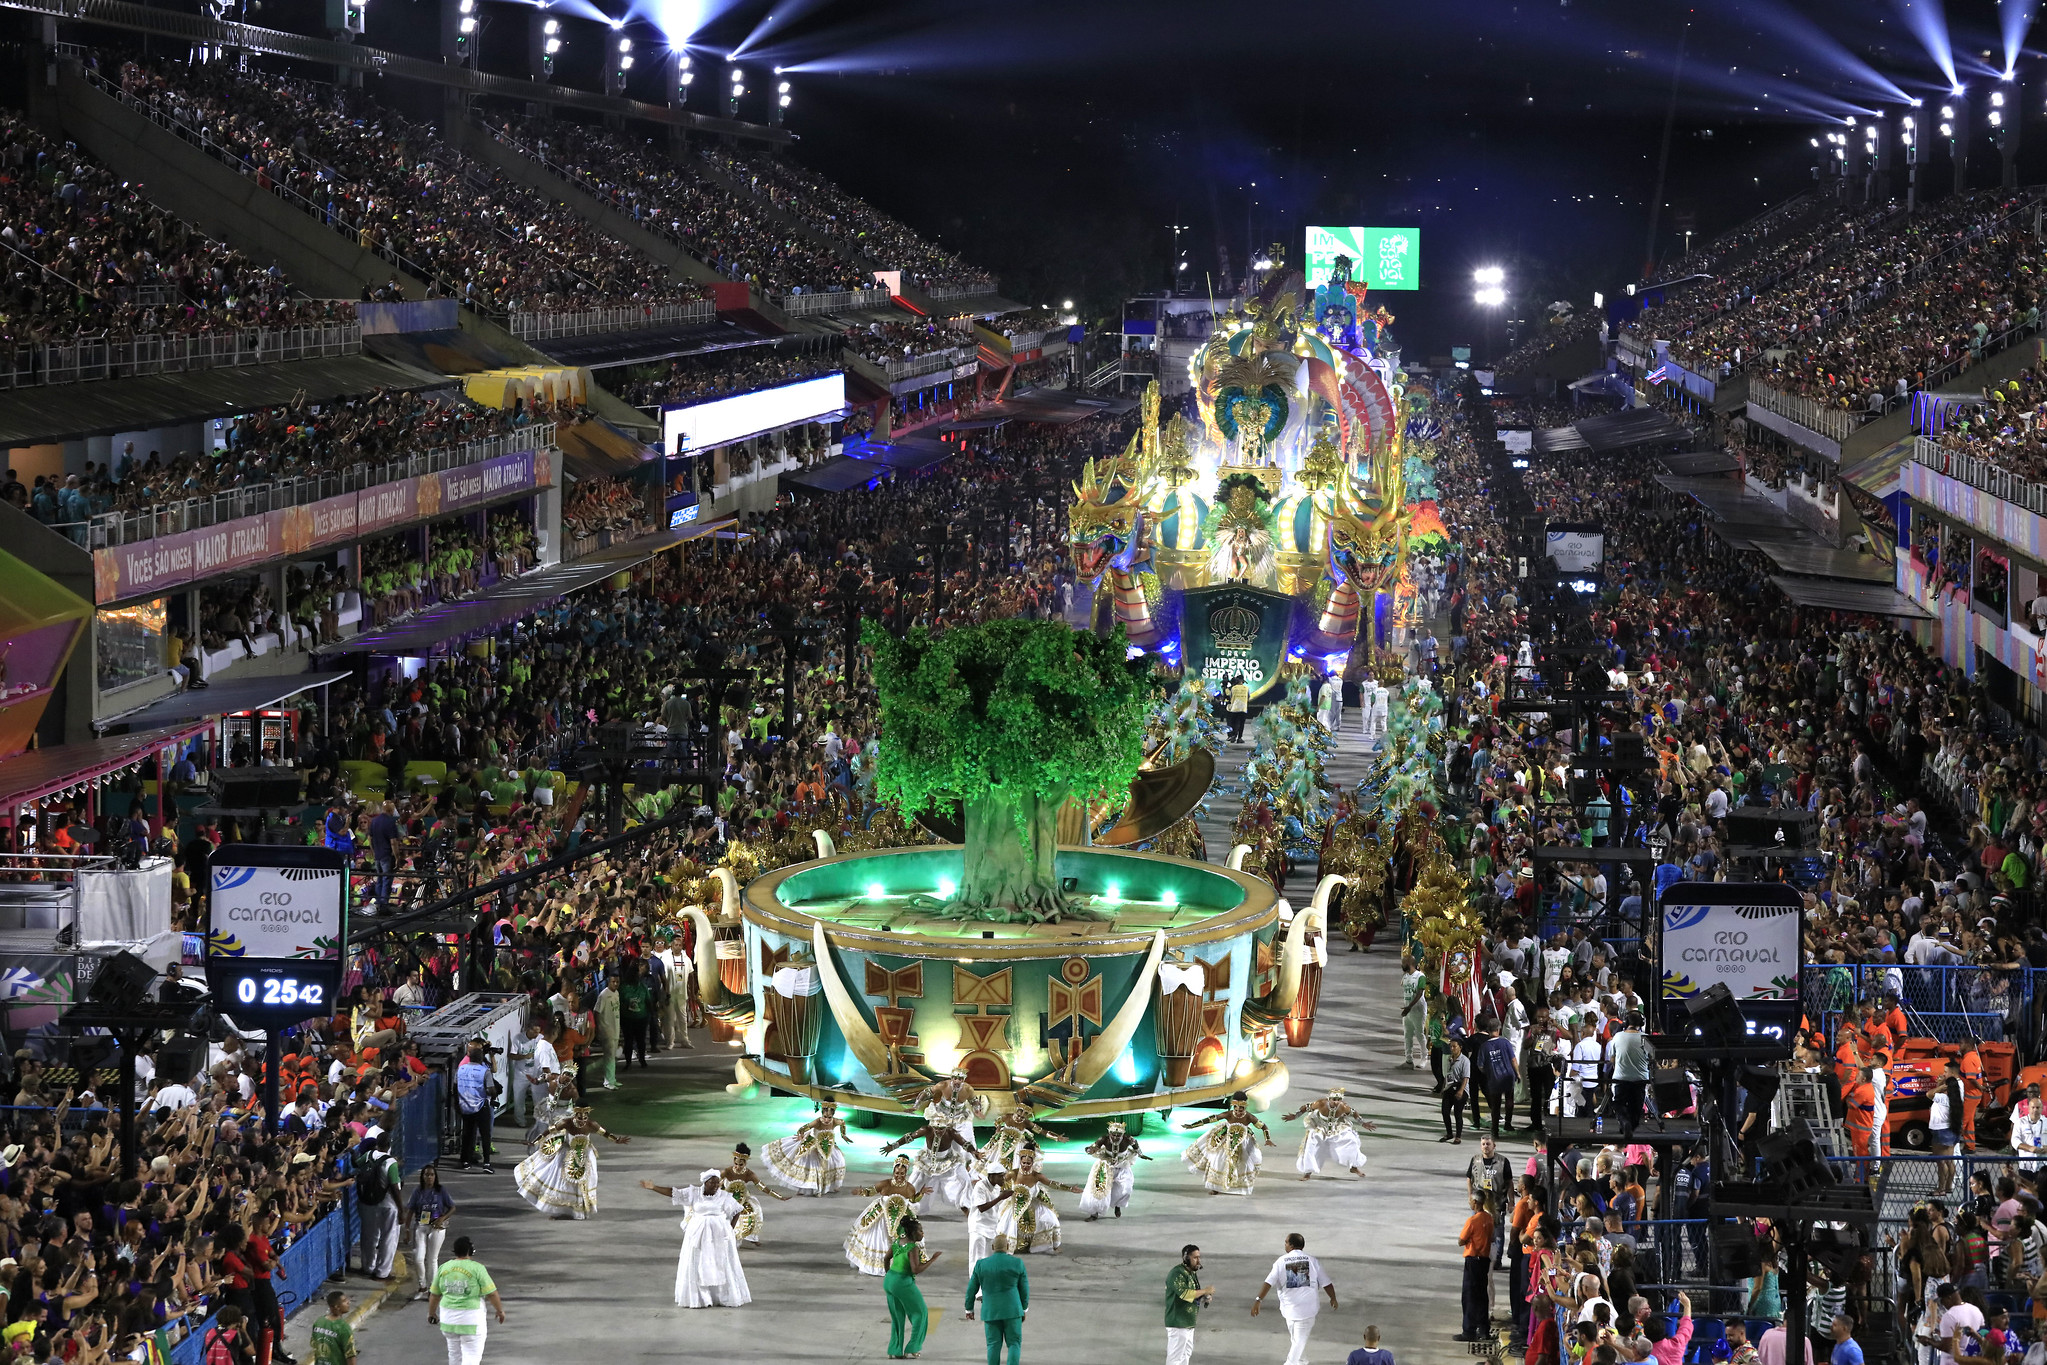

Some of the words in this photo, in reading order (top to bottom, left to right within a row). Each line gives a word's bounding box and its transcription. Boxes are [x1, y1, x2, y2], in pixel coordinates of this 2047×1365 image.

[460, 475, 469, 498] SÃO
[484, 464, 501, 493] MAIOR
[330, 504, 341, 532] SÃO
[358, 496, 376, 526] MAIOR
[378, 484, 406, 522] ATRAÇÃO!
[155, 545, 169, 576] SÃO
[171, 547, 192, 572] NOSSA
[196, 533, 228, 571] MAIOR
[231, 521, 269, 559] ATRAÇÃO!
[1205, 656, 1260, 670] IMPÉRIO
[1202, 667, 1264, 681] SERRANO
[260, 892, 292, 906] RIO
[1714, 931, 1748, 945] RIO
[77, 970, 93, 979] DE
[238, 978, 256, 1003] 0
